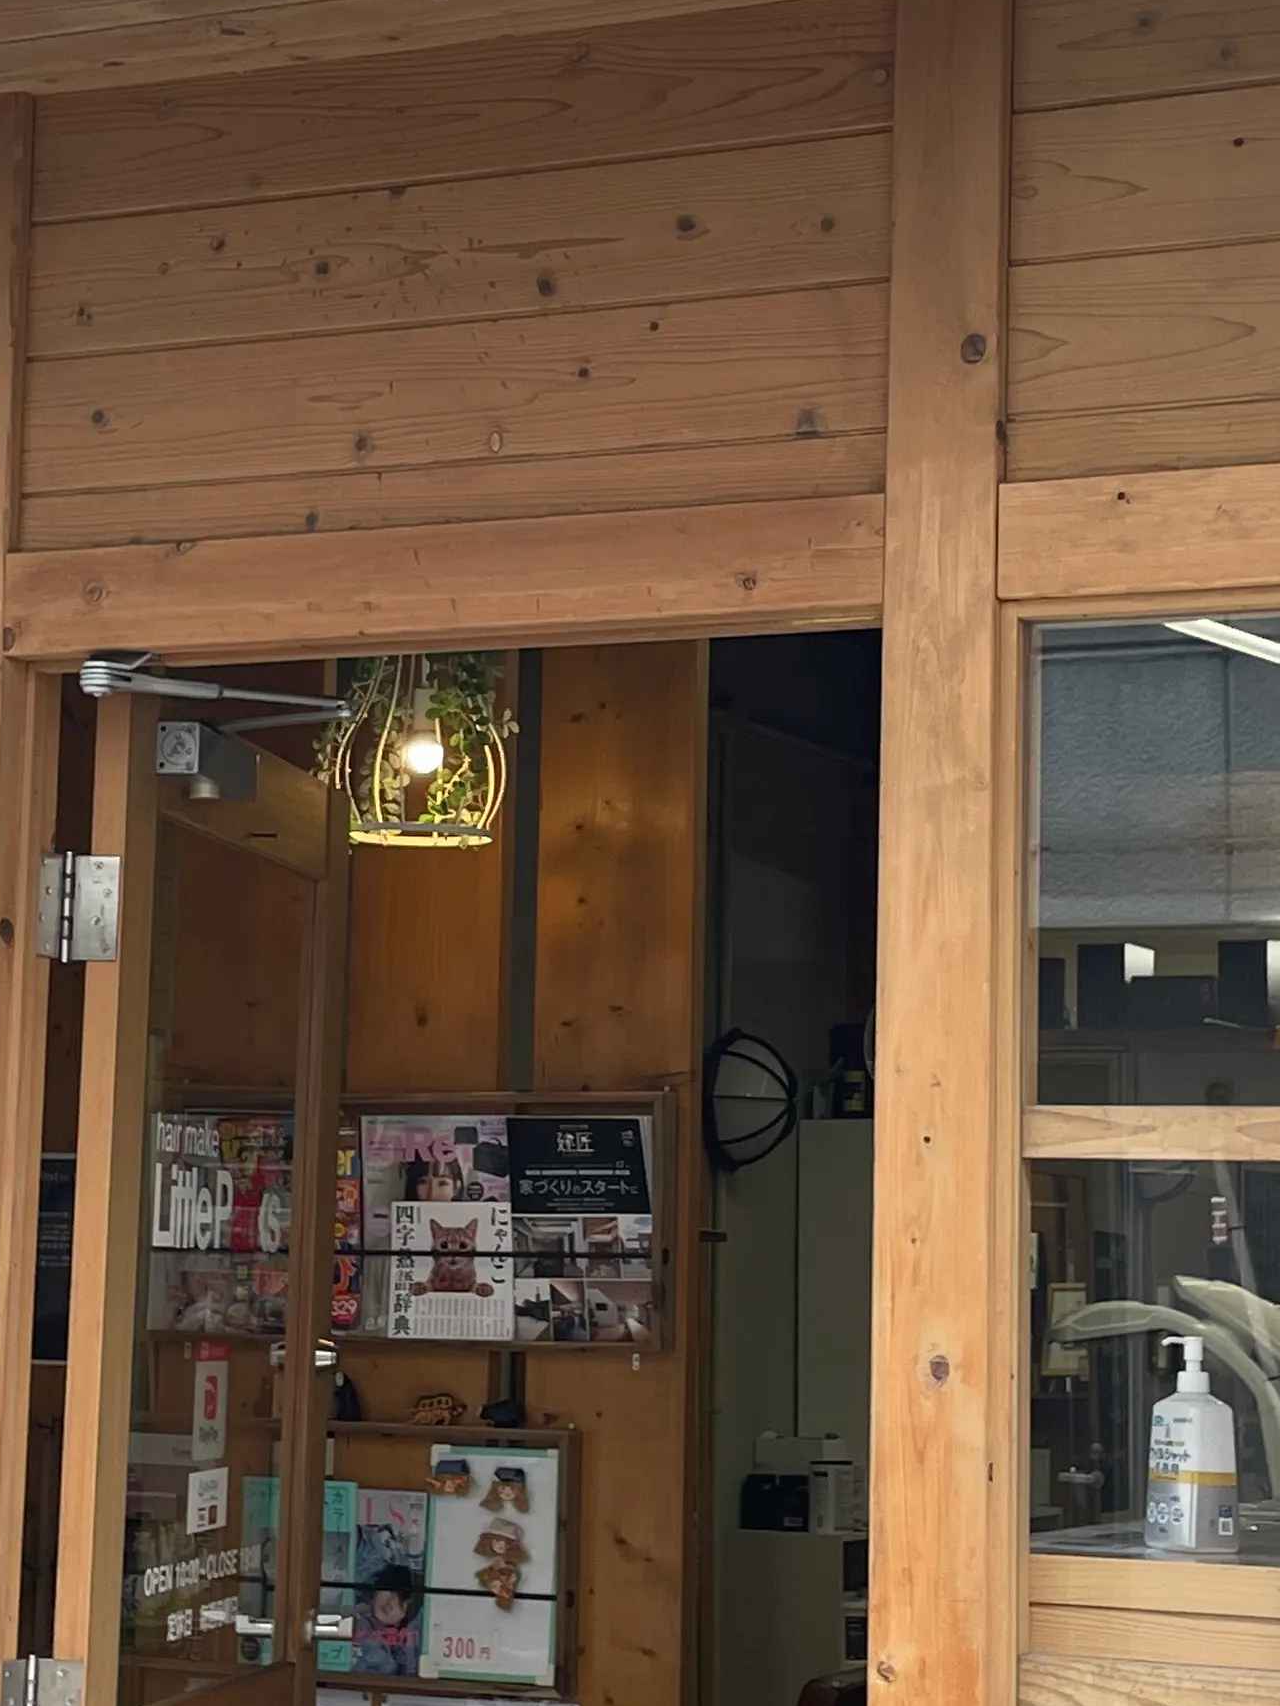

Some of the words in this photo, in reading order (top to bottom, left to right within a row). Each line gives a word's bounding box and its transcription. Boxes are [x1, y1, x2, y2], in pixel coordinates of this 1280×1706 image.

[155, 1111, 182, 1153] hair
[184, 1116, 221, 1159] make
[151, 1162, 213, 1251] Little
